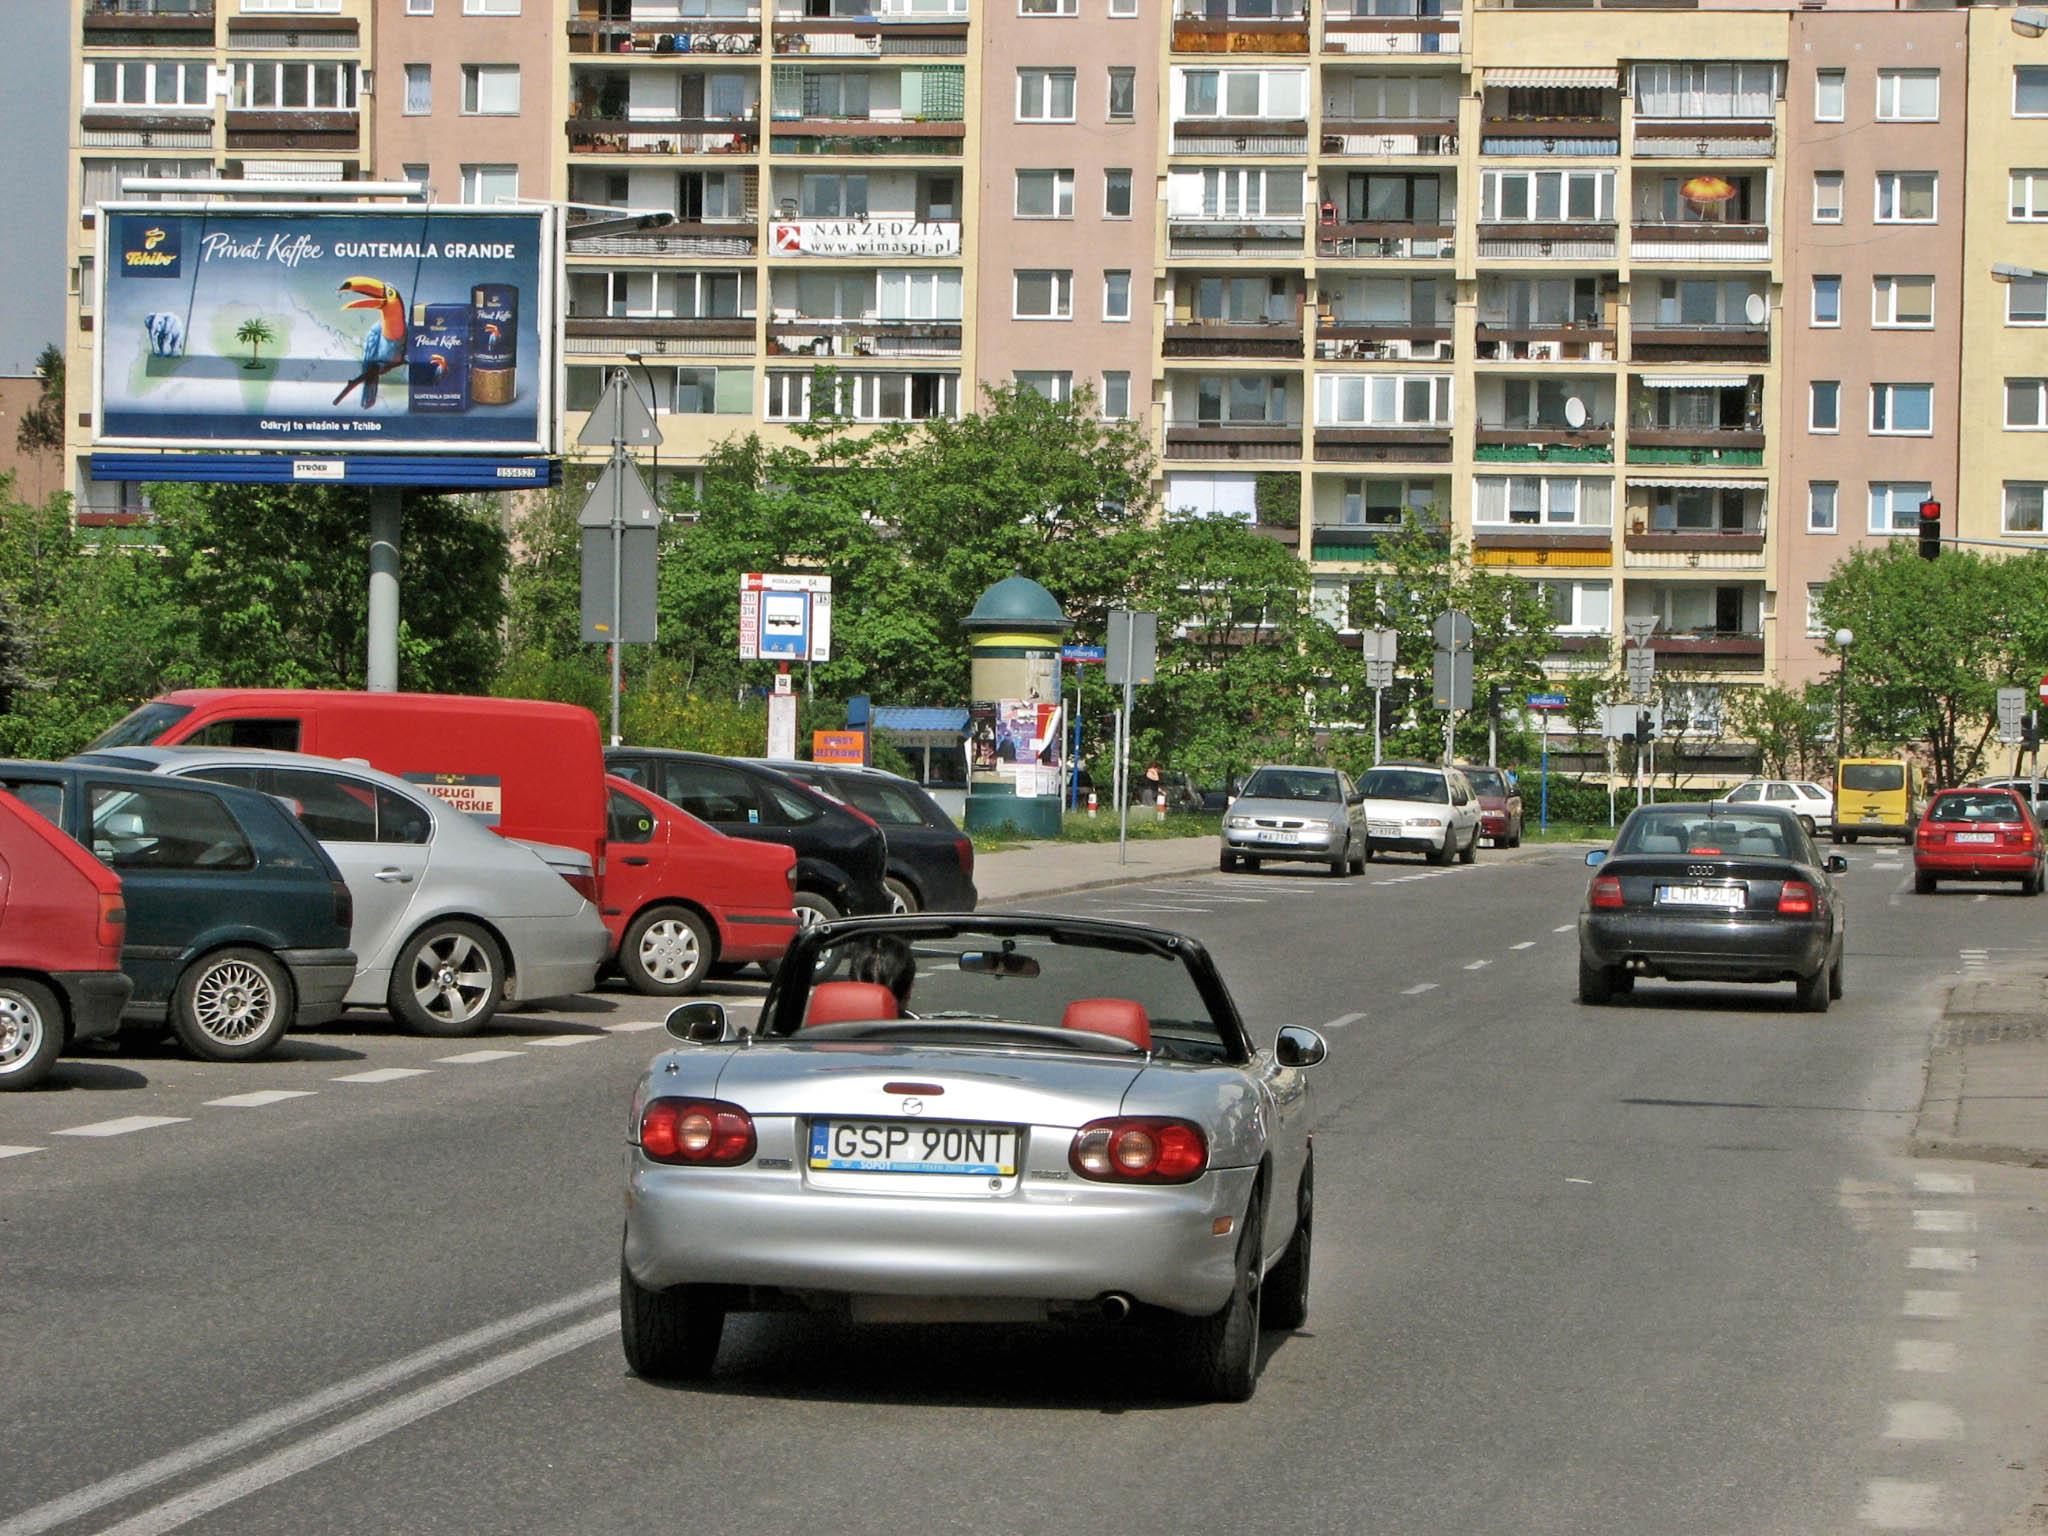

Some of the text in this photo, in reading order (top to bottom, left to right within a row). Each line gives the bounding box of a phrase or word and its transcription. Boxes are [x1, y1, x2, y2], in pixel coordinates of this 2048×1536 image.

[815, 222, 943, 238] NARZĘDZIA
[202, 232, 325, 268] Privat Kaffee
[334, 243, 515, 259] GUATEMALA GRANDE
[810, 240, 952, 256] www.wimaspj.pl
[125, 251, 177, 266] Tchibo
[260, 420, 291, 432] Odkryj
[293, 421, 304, 430] to
[305, 420, 340, 431] właśnie
[352, 421, 381, 431] Tchibo
[742, 607, 755, 616] 314
[741, 646, 753, 656] 741
[814, 1145, 827, 1154] PL
[834, 1124, 1010, 1163] GSP 90NT
[860, 1160, 891, 1170] SOPOT
